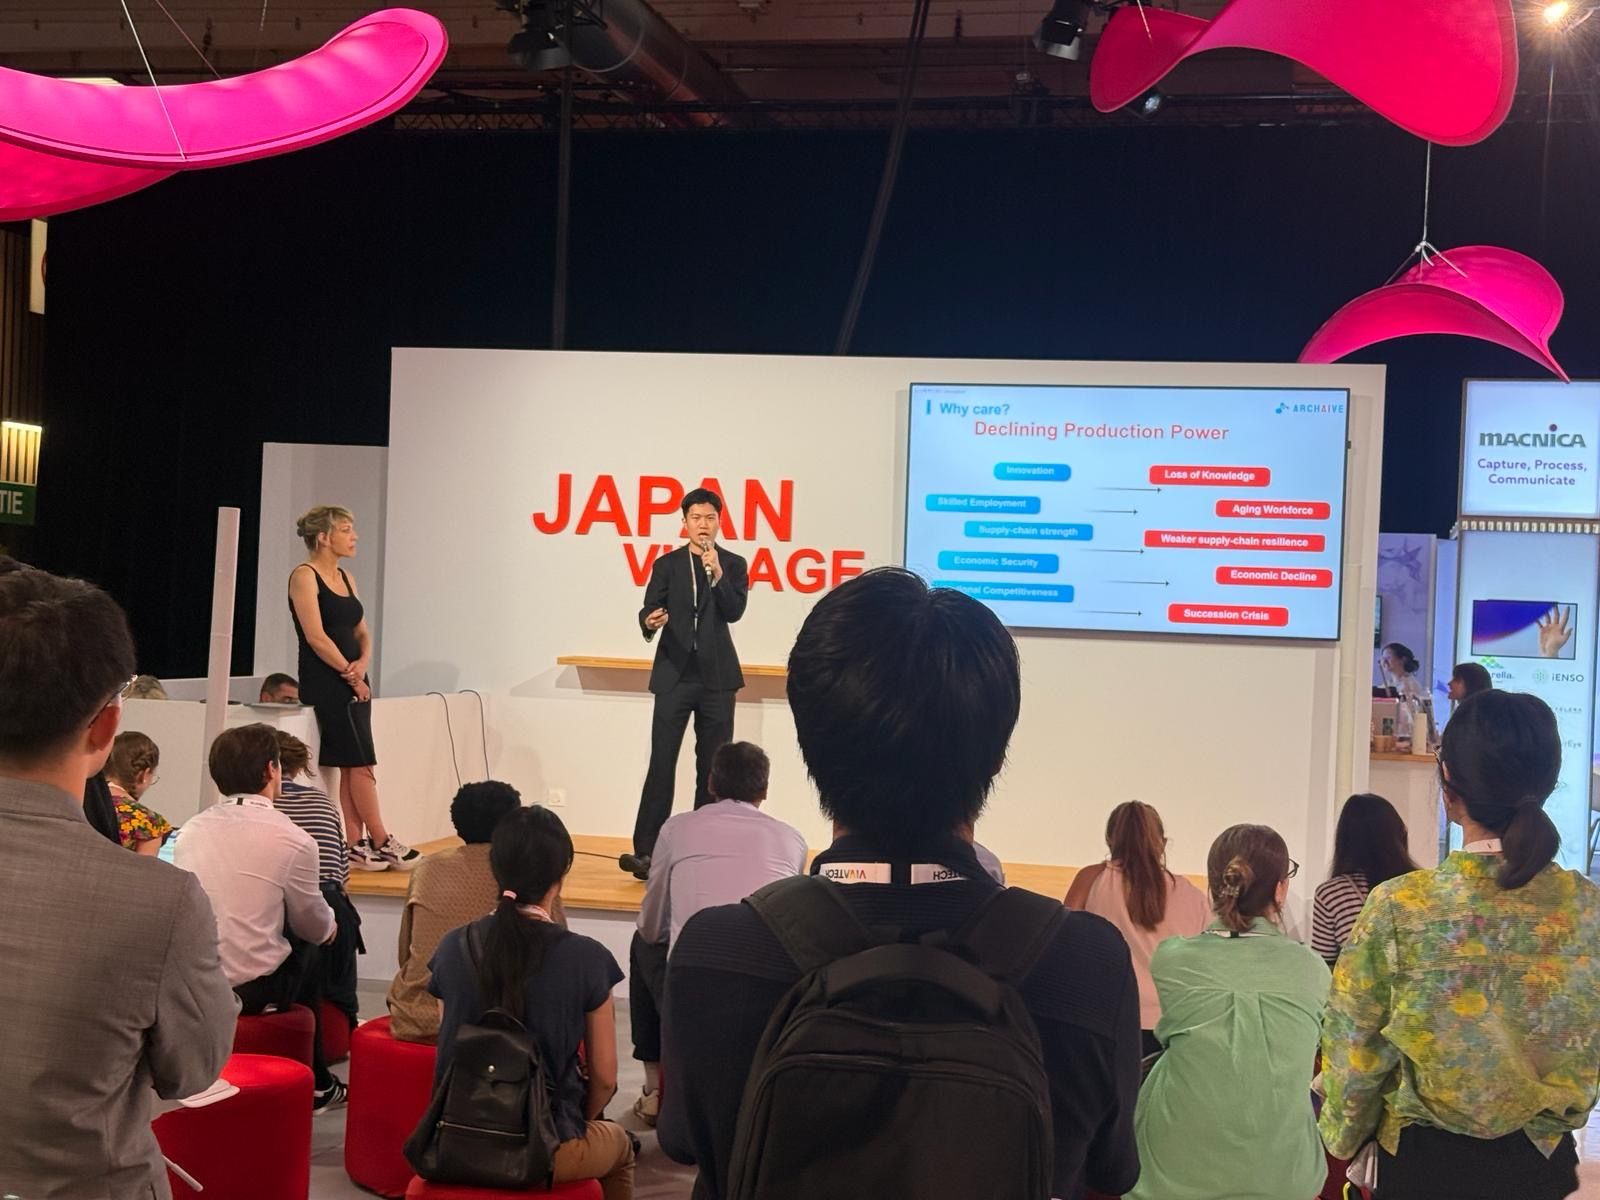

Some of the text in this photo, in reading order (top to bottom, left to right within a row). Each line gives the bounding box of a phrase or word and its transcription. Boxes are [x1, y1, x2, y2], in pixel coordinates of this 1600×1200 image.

[939, 402, 1010, 416] Why care?
[1293, 404, 1344, 413] ARCHAIVE
[975, 421, 1229, 440] Declining Production Power
[1006, 465, 1054, 475] Innovation
[1477, 459, 1587, 472] Capture, Process,
[1164, 470, 1255, 482] Loss of Knowledge
[1488, 474, 1575, 485] Communicate
[970, 498, 1026, 509] Employment
[1232, 504, 1314, 515] Aging Workforce
[979, 525, 1078, 537] Supply-chain strength
[1161, 533, 1308, 547] Weaker supply-chain resilience
[954, 556, 1039, 568] Economic Security
[623, 543, 865, 594] VAGE
[1230, 570, 1317, 581] Economic Decline
[983, 586, 1058, 597] Competitiveness
[1184, 609, 1269, 621] Succession Crisis
[1552, 672, 1584, 682] iENSO
